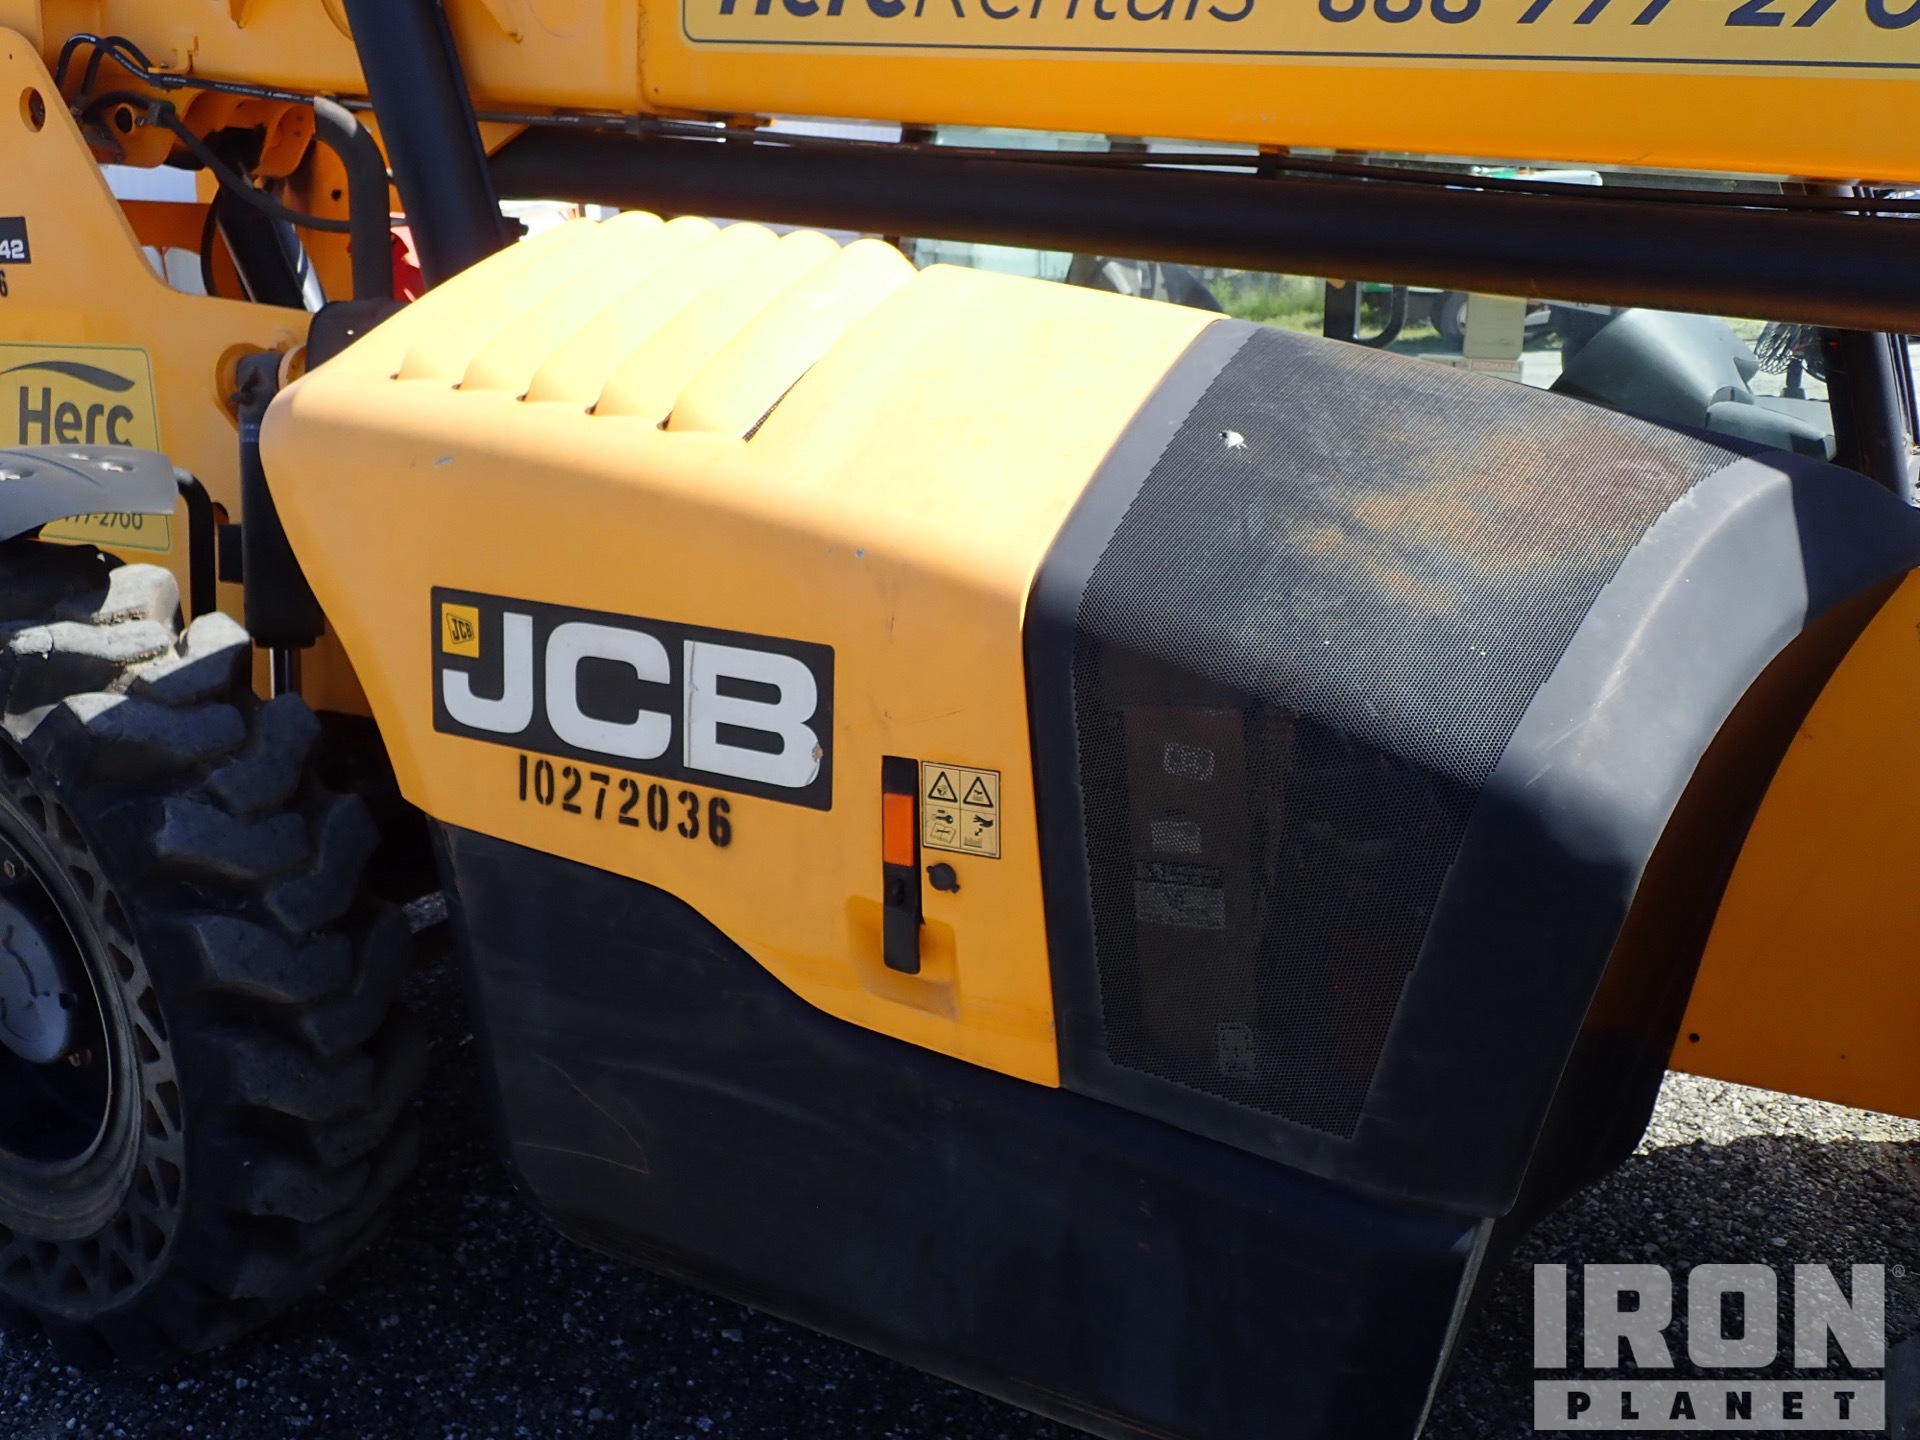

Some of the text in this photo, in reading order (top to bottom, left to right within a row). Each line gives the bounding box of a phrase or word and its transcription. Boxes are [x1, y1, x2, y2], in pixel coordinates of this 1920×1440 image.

[19, 386, 134, 448] Herc
[452, 618, 472, 640] JCB
[443, 612, 821, 788] JCB
[519, 755, 732, 848] 10272036
